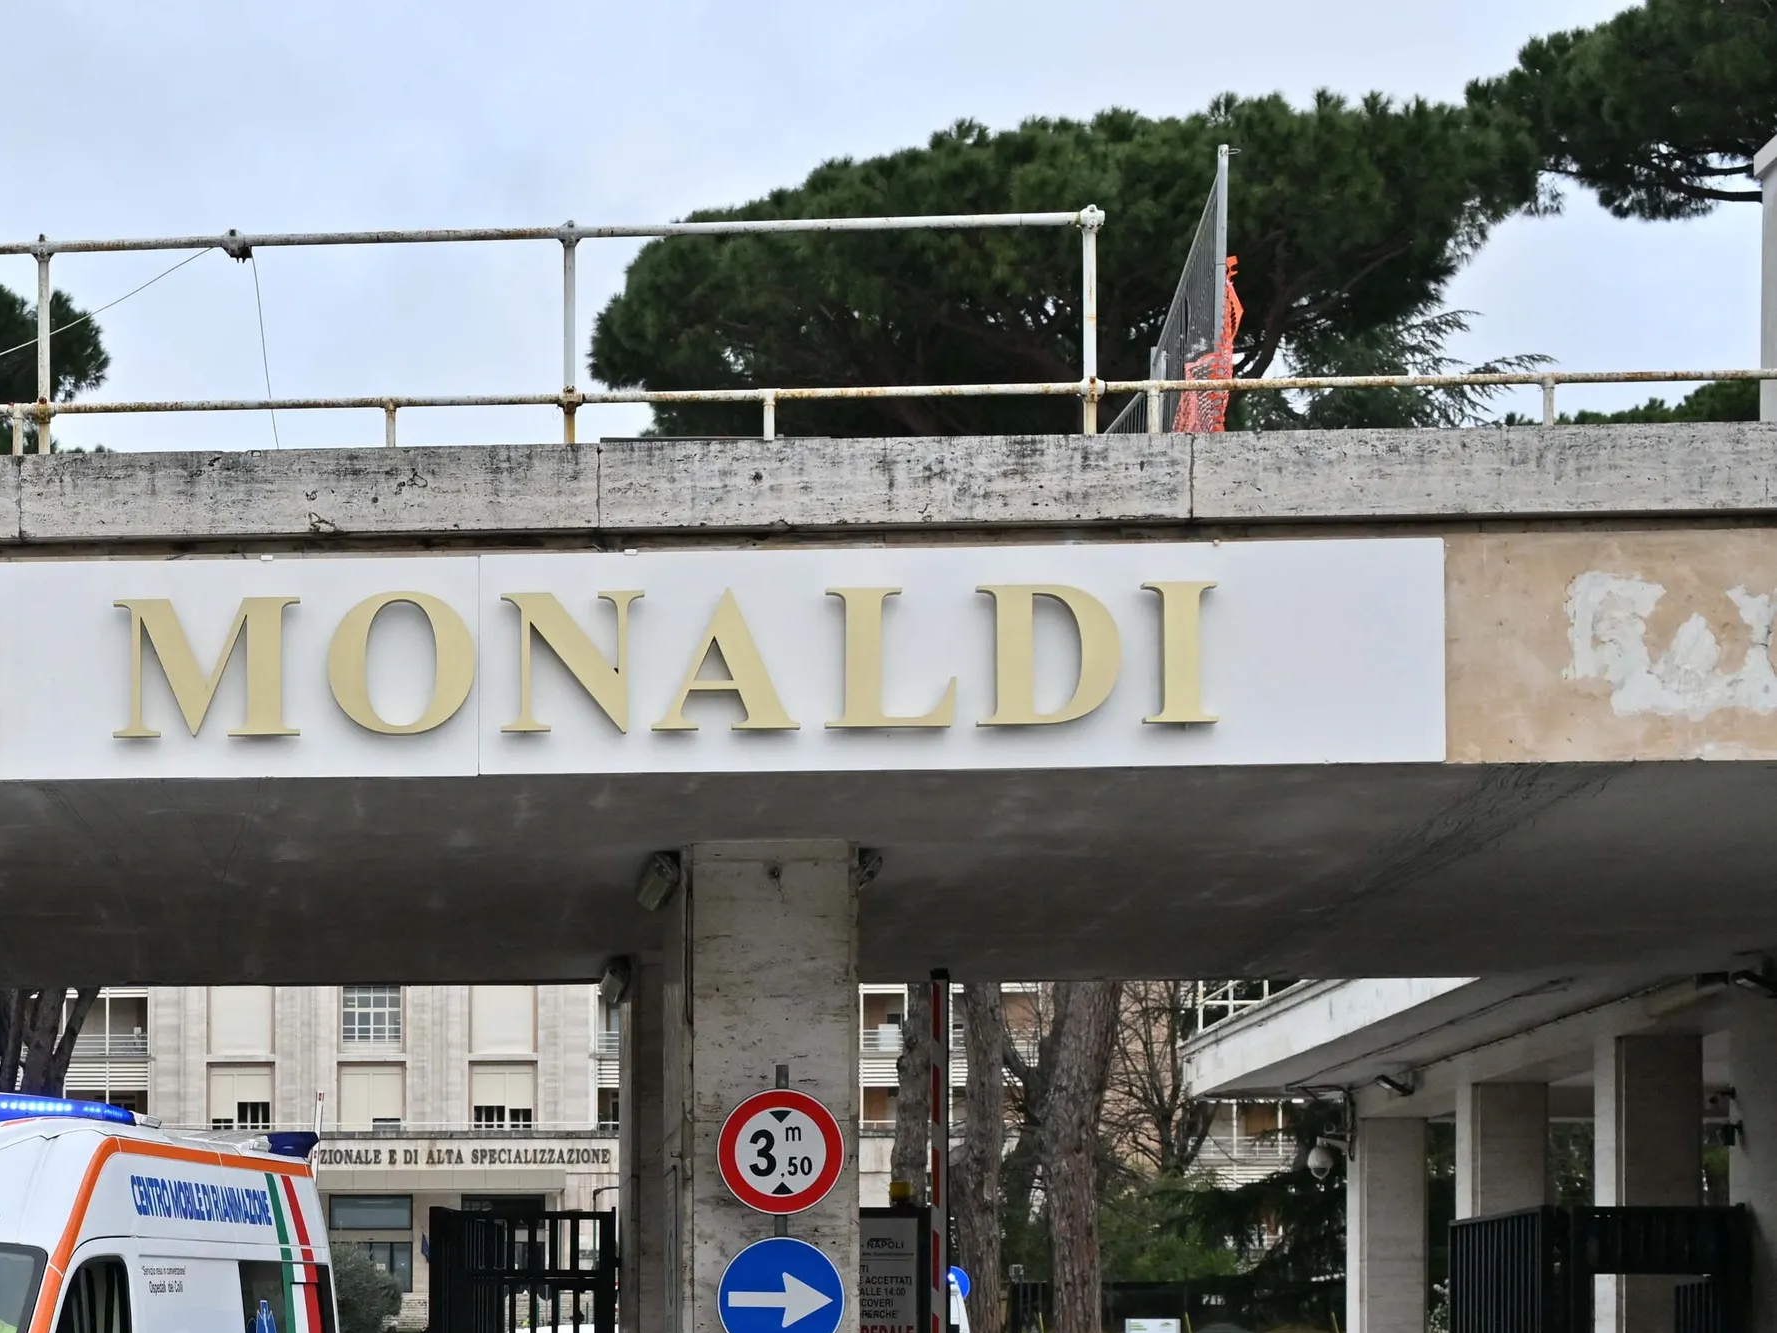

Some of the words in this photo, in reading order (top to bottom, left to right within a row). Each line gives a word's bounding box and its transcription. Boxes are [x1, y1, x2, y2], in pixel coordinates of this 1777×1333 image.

[112, 581, 1221, 738] MONALDI
[320, 1148, 381, 1166] ZIONALE
[388, 1148, 397, 1165] E
[404, 1148, 419, 1165] DI
[425, 1148, 464, 1165] ALTA
[471, 1148, 611, 1165] SPECIALIZZAZIONE
[131, 1175, 171, 1218] CENTRO
[168, 1180, 206, 1220] MOBILE
[867, 1240, 905, 1249] NAPOLI
[860, 1299, 894, 1307] COVERI
